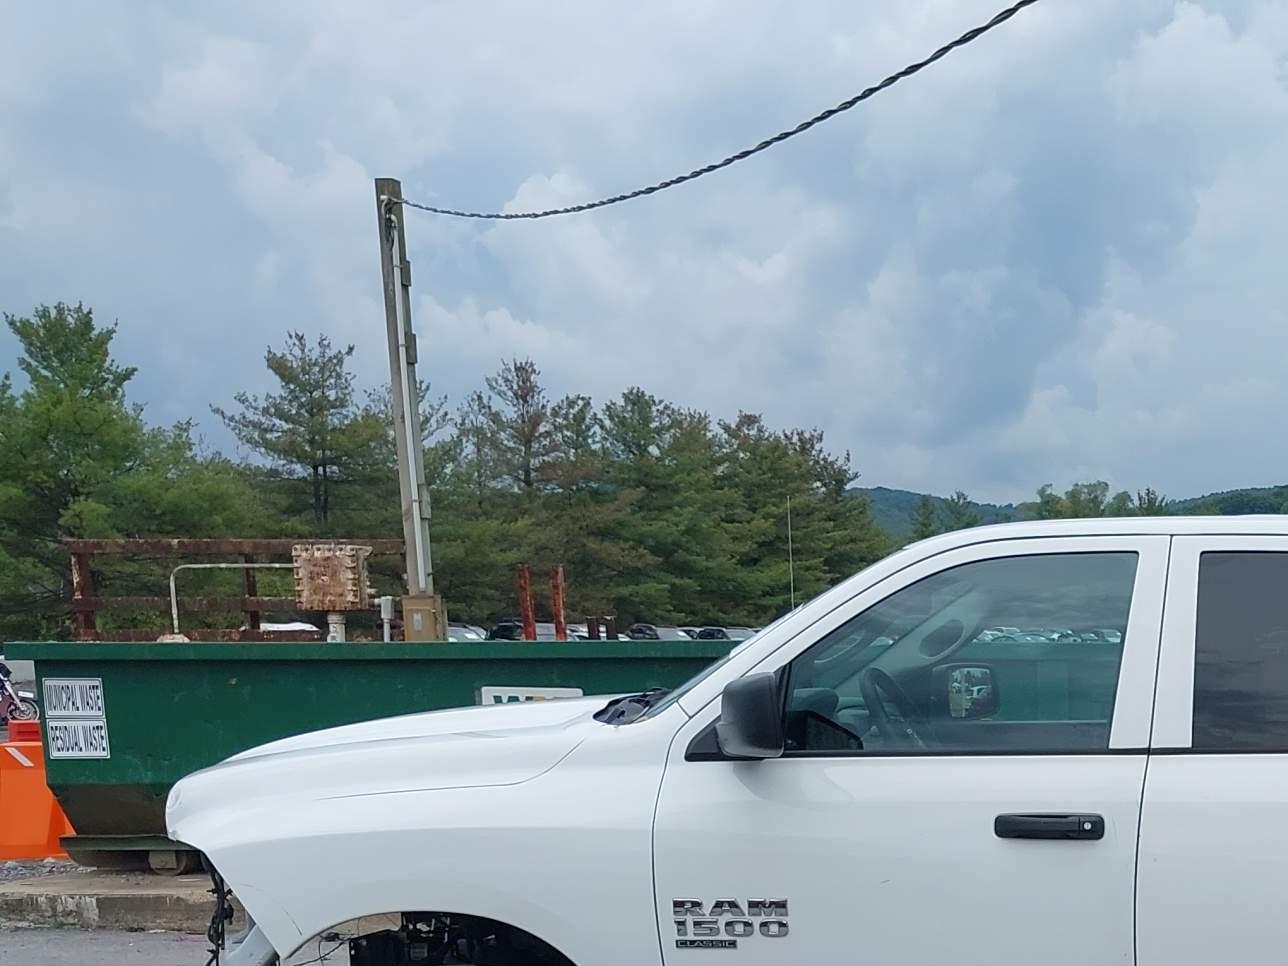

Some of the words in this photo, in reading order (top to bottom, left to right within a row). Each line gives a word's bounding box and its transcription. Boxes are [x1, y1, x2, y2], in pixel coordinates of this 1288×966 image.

[46, 684, 80, 711] MUNICIPAL
[79, 684, 102, 711] WASTE
[50, 725, 83, 752] RESIDUAL
[82, 725, 106, 752] WASTE
[672, 897, 788, 916] RAM
[674, 918, 789, 937] 1500
[677, 940, 737, 948] CLASSIC
